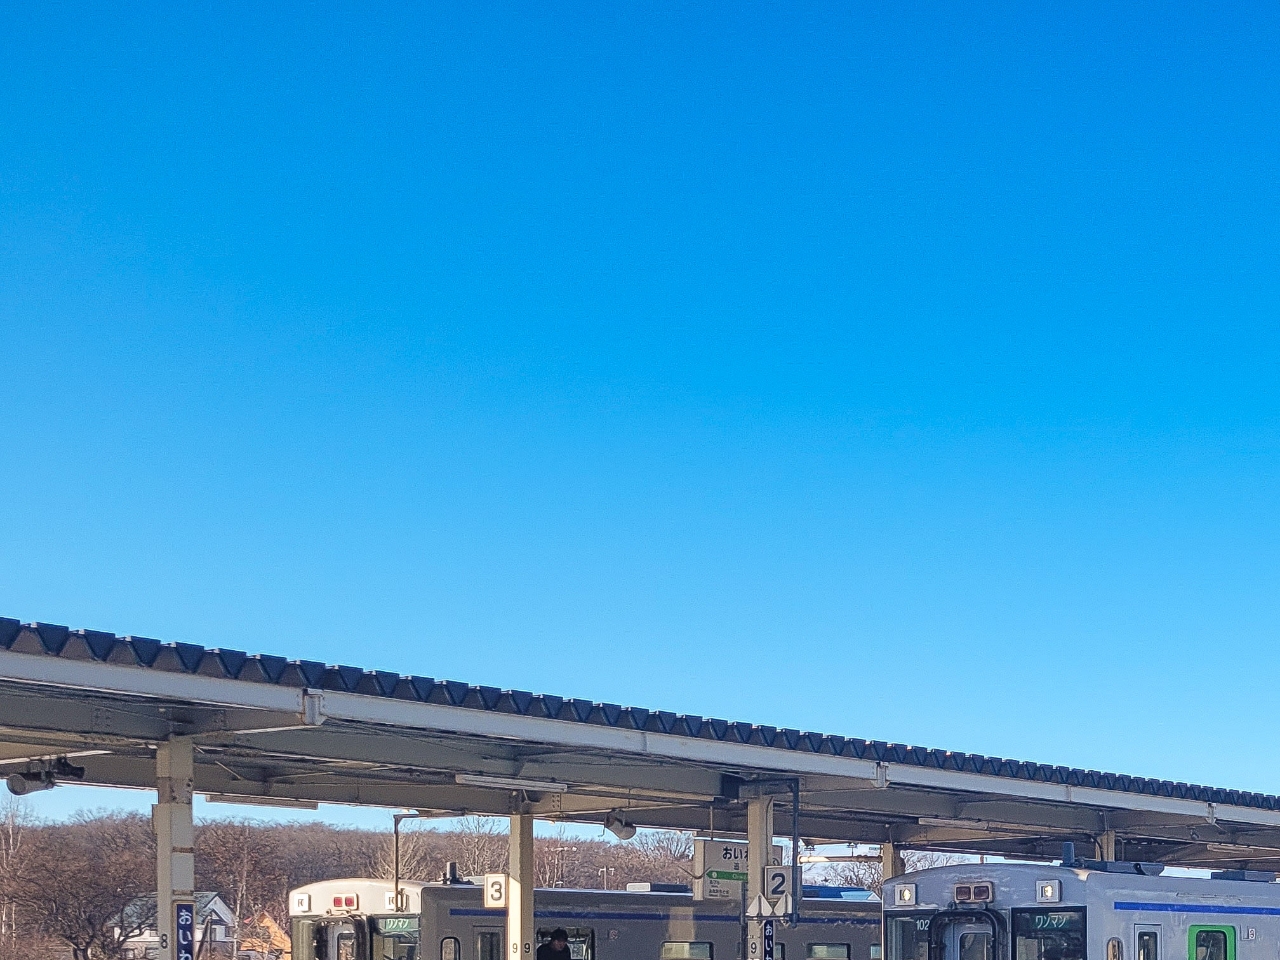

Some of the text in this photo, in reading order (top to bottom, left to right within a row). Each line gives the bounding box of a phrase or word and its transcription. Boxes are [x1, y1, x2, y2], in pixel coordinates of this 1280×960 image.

[771, 872, 786, 895] 2
[490, 881, 503, 901] 3
[386, 918, 409, 928] ワンマン
[916, 919, 930, 931] 102
[1035, 915, 1068, 929] ワンマン
[161, 933, 168, 949] 8
[512, 942, 518, 954] 9
[523, 942, 531, 954] 9
[750, 942, 757, 954] 9
